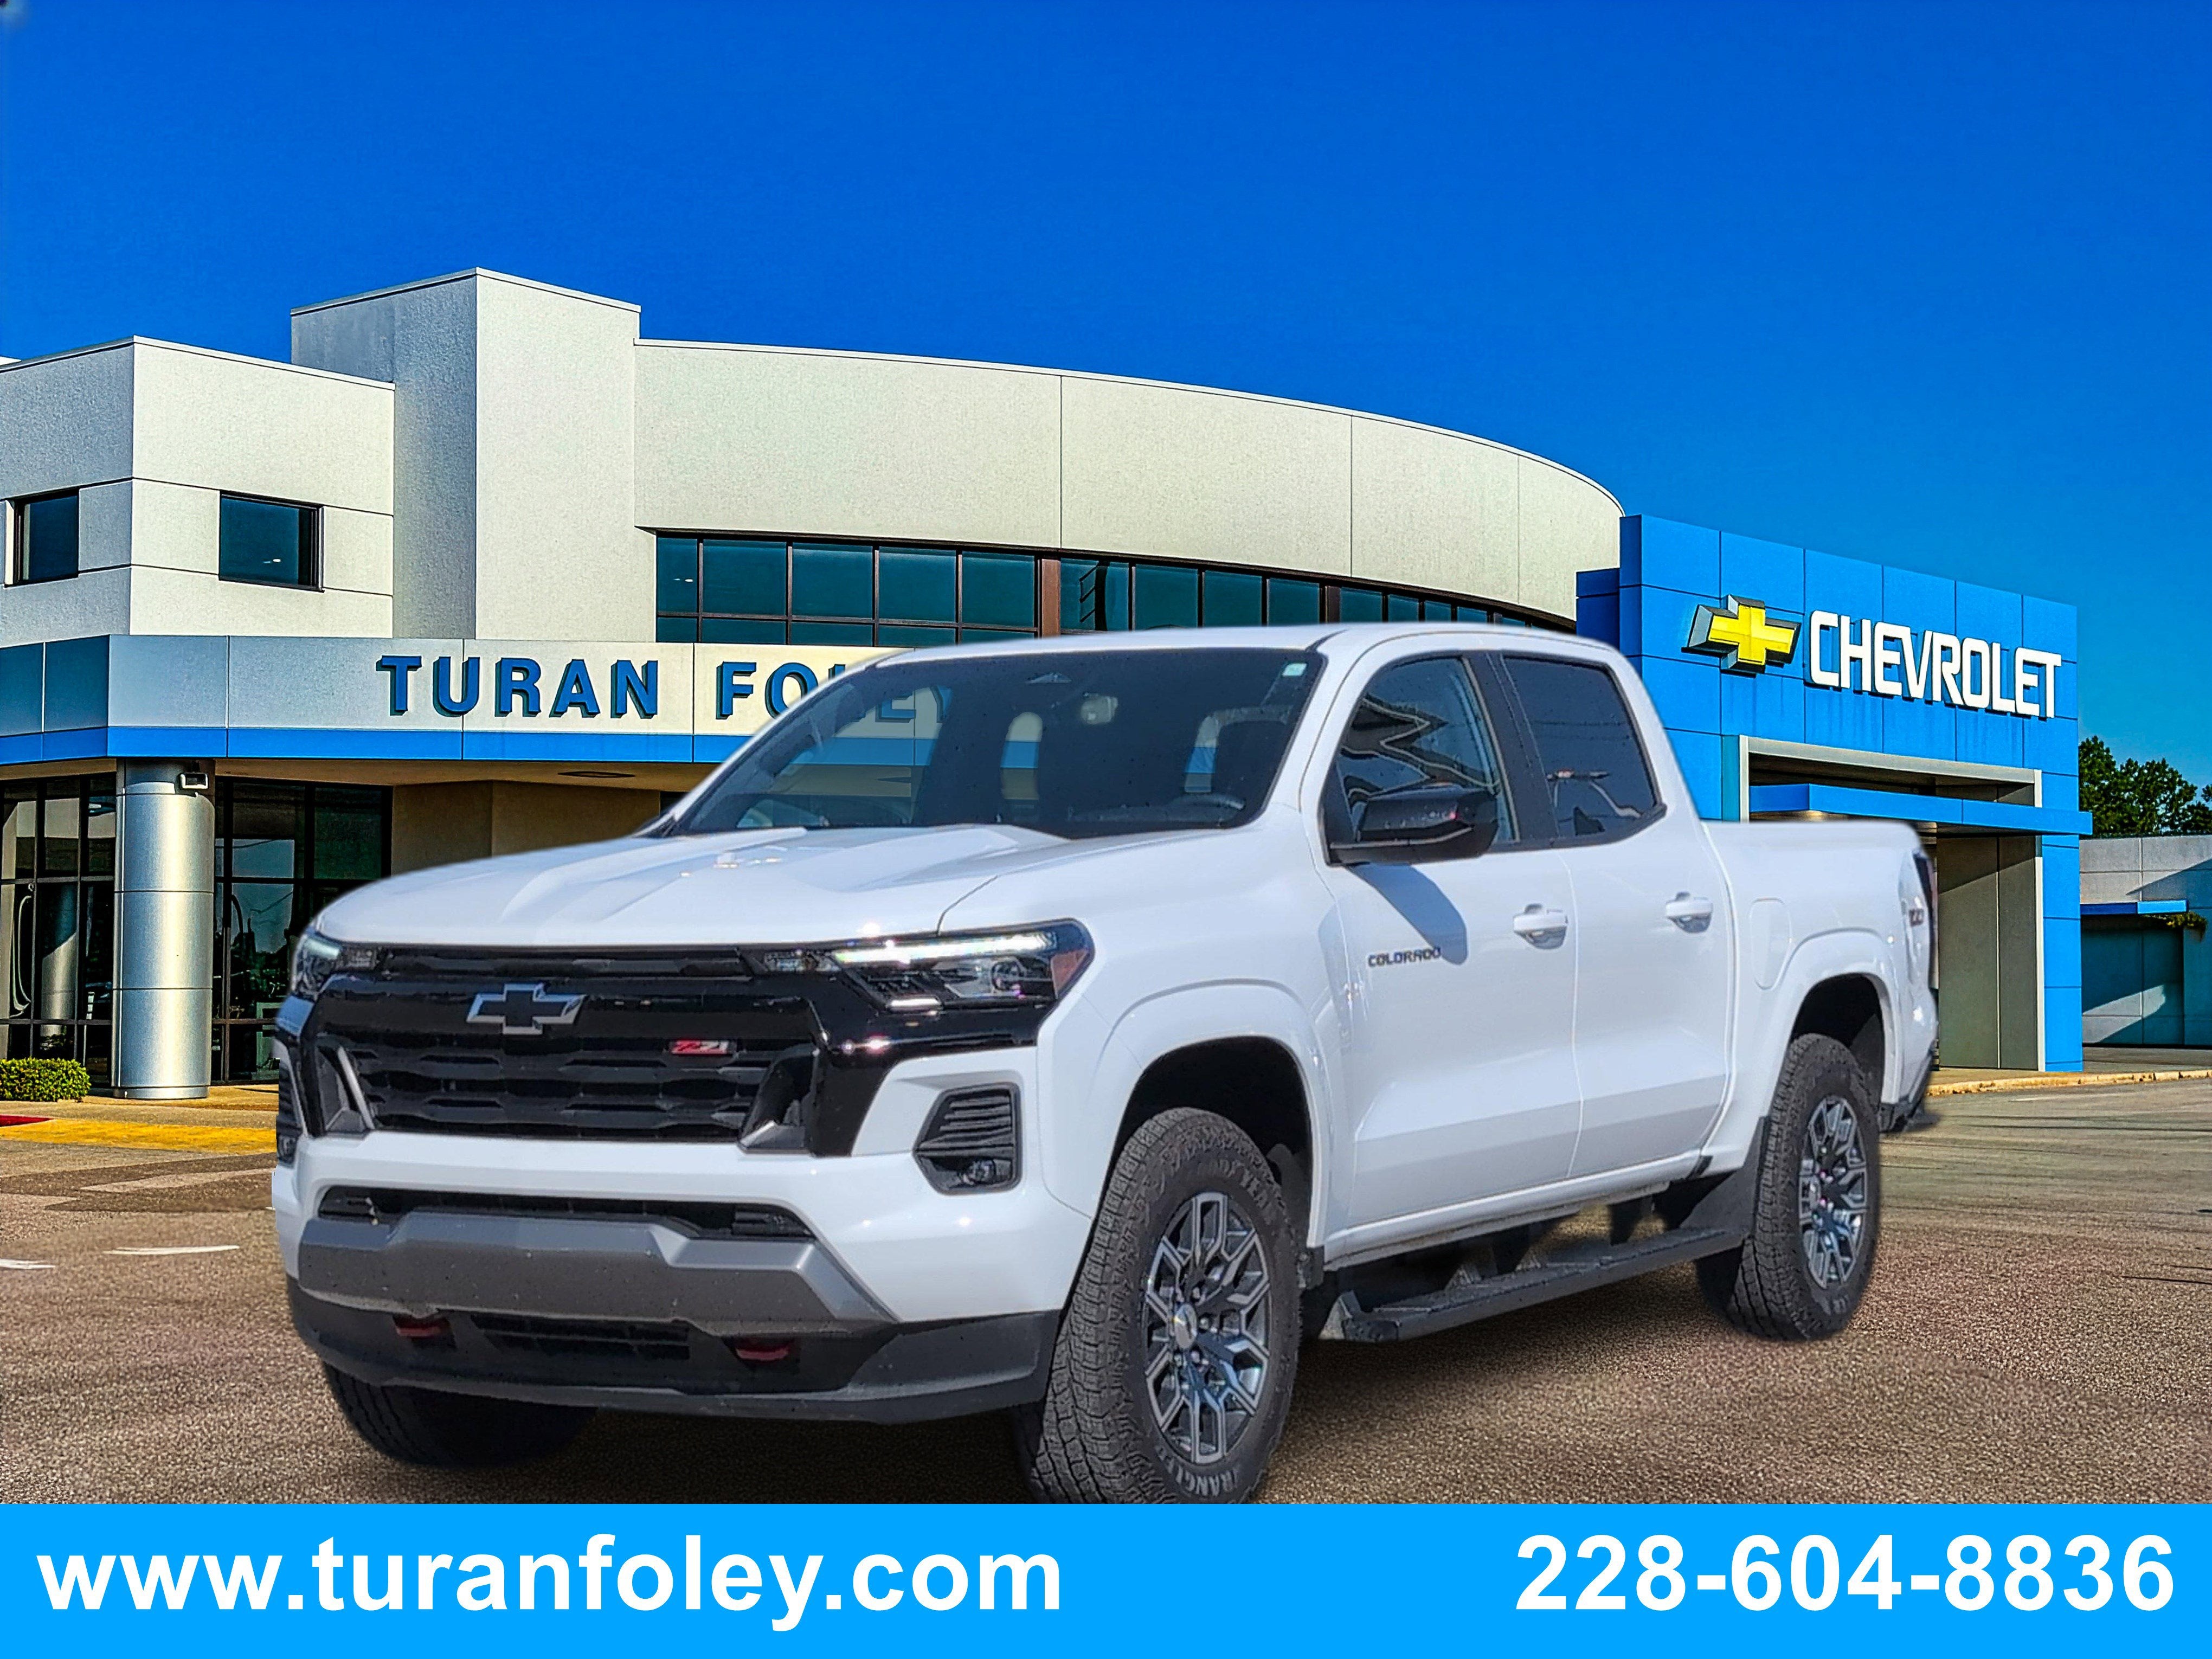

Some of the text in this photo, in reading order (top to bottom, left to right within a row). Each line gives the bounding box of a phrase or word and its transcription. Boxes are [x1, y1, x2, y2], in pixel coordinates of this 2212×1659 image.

[376, 655, 658, 719] TURAN
[1808, 610, 2062, 719] CHEVROLET
[1368, 947, 1441, 967] COLORADO
